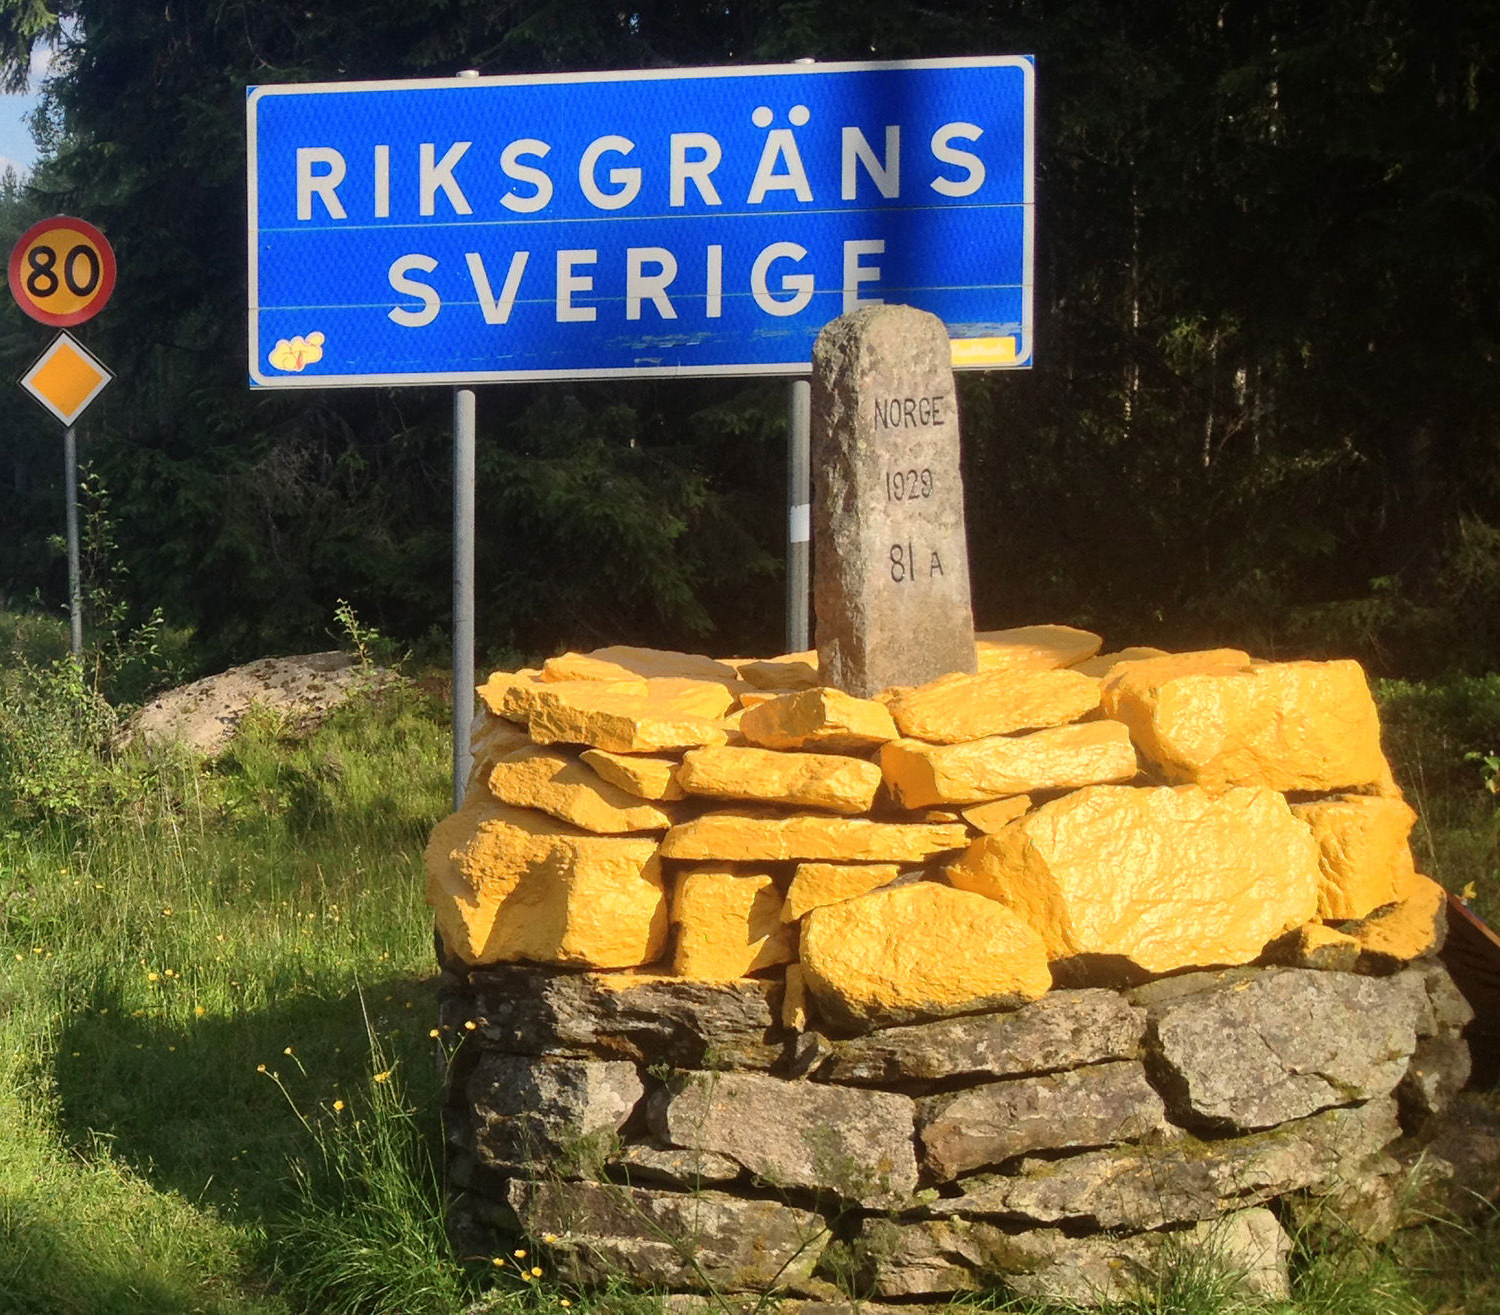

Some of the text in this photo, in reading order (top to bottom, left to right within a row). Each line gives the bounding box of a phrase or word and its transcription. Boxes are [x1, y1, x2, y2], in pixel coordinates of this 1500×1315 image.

[296, 104, 986, 221] RIKSGRÄNS
[26, 244, 100, 298] 80
[387, 239, 886, 328] SVERIGE
[874, 396, 944, 431] NORGE
[886, 469, 934, 501] 1929
[889, 541, 944, 583] 81 A
